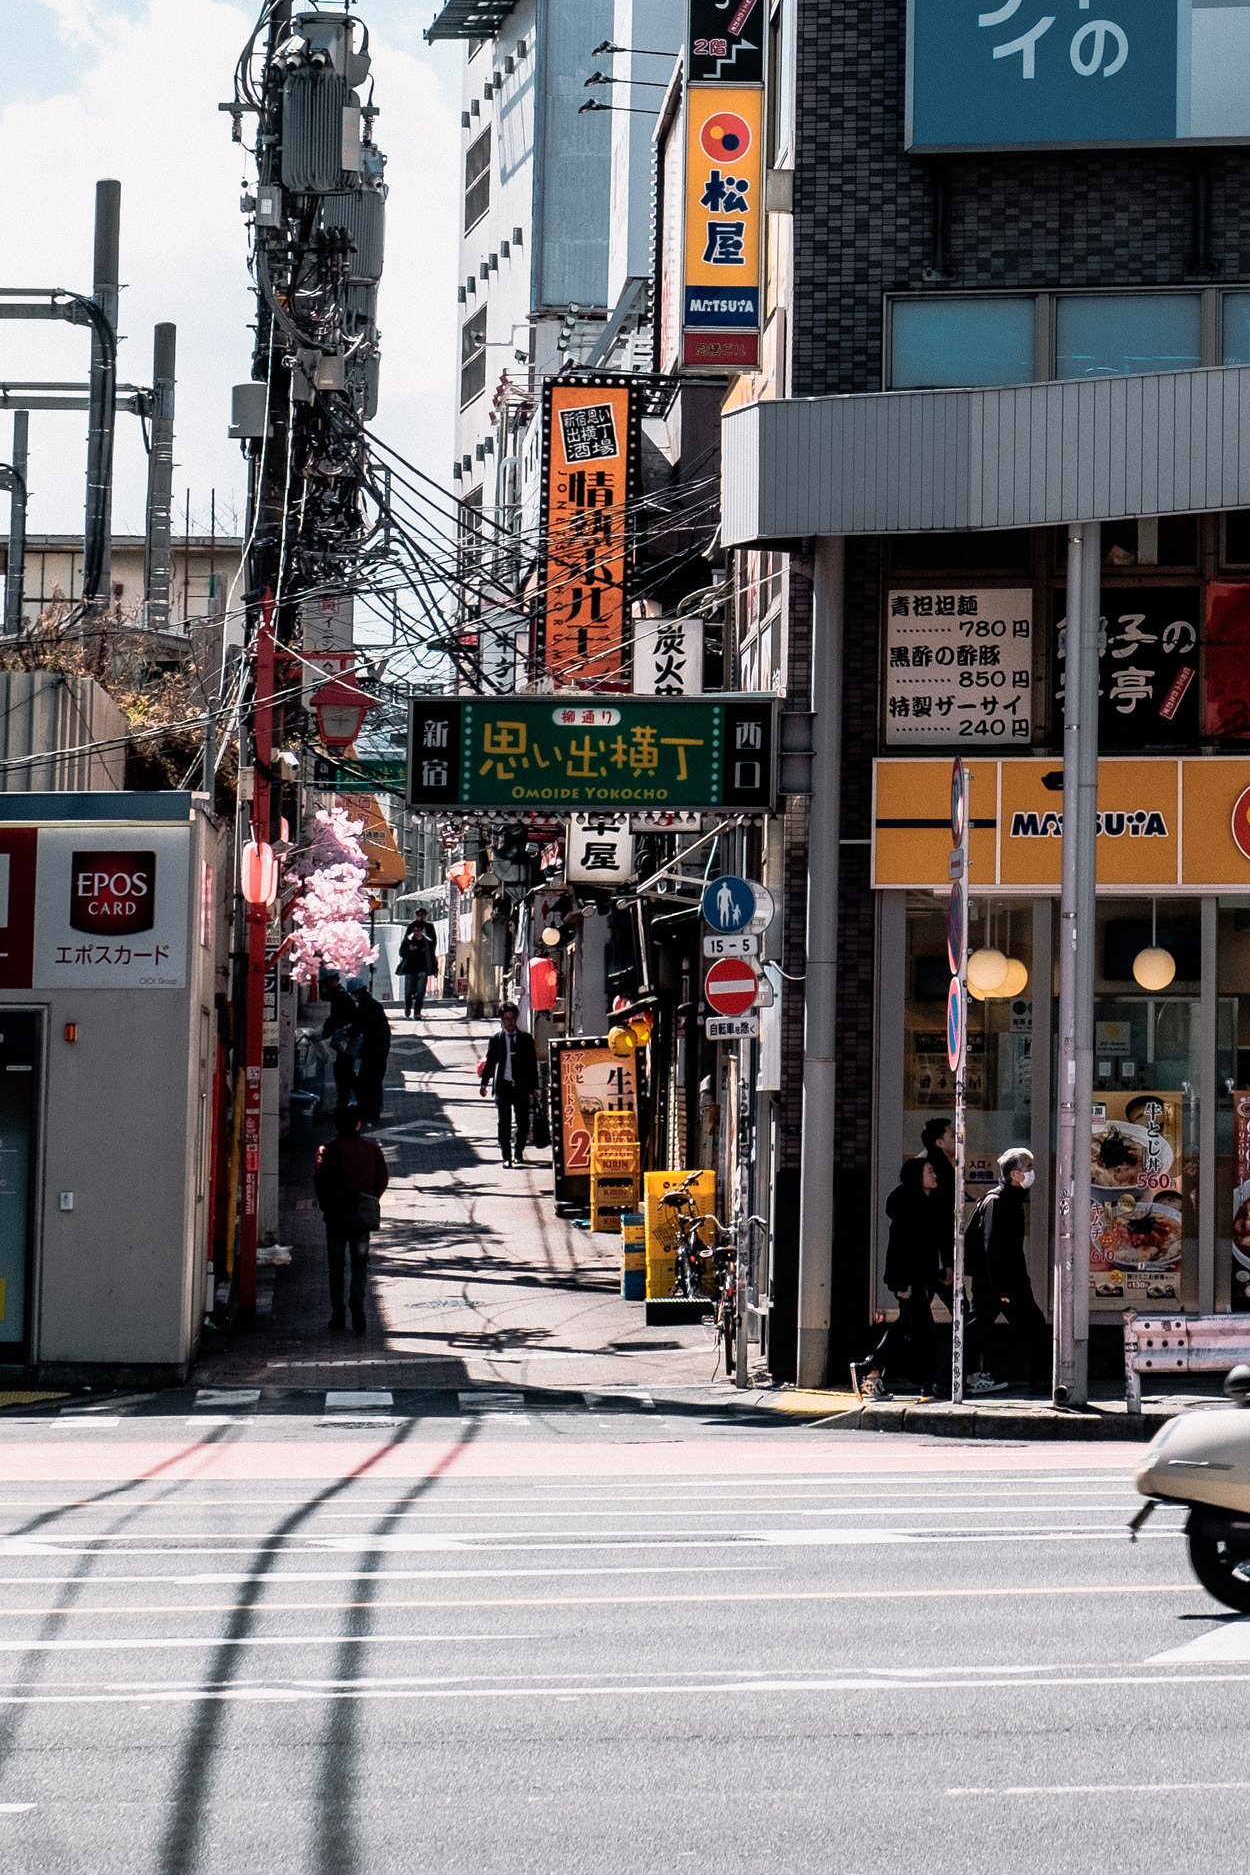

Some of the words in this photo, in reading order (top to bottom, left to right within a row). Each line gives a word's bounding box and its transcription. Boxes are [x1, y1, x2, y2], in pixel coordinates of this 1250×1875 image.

[693, 38, 727, 56] 2階
[700, 169, 751, 265] 松屋
[690, 299, 754, 313] MATSUYA
[563, 409, 611, 427] 新宿思い
[568, 440, 615, 460] 酒場
[959, 619, 1030, 638] 780円
[890, 644, 1001, 668] 黒酢の酢豚
[959, 670, 1030, 688] 850円
[890, 694, 1021, 718] 特製ザーサイ
[561, 709, 613, 725] 柳通り
[959, 719, 1029, 737] 240円
[422, 720, 448, 788] 新宿
[479, 721, 704, 781] 思い出横丁
[735, 722, 762, 788] 西口
[1010, 809, 1169, 838] MAUYA
[77, 873, 148, 897] EPOS
[88, 901, 136, 915] CARD
[711, 939, 723, 953] 15
[742, 938, 750, 952] 5
[55, 945, 170, 966] エポスカード
[158, 978, 178, 986] Group
[709, 1022, 756, 1037] 自転車を除く
[574, 1052, 585, 1085] アサヒ
[563, 1052, 575, 1128] スーパードライ
[1144, 1101, 1163, 1173] 牛とじ丼
[602, 1158, 629, 1169] KIRIN
[1137, 1173, 1177, 1190] 560円
[603, 1188, 628, 1197] KIRIN
